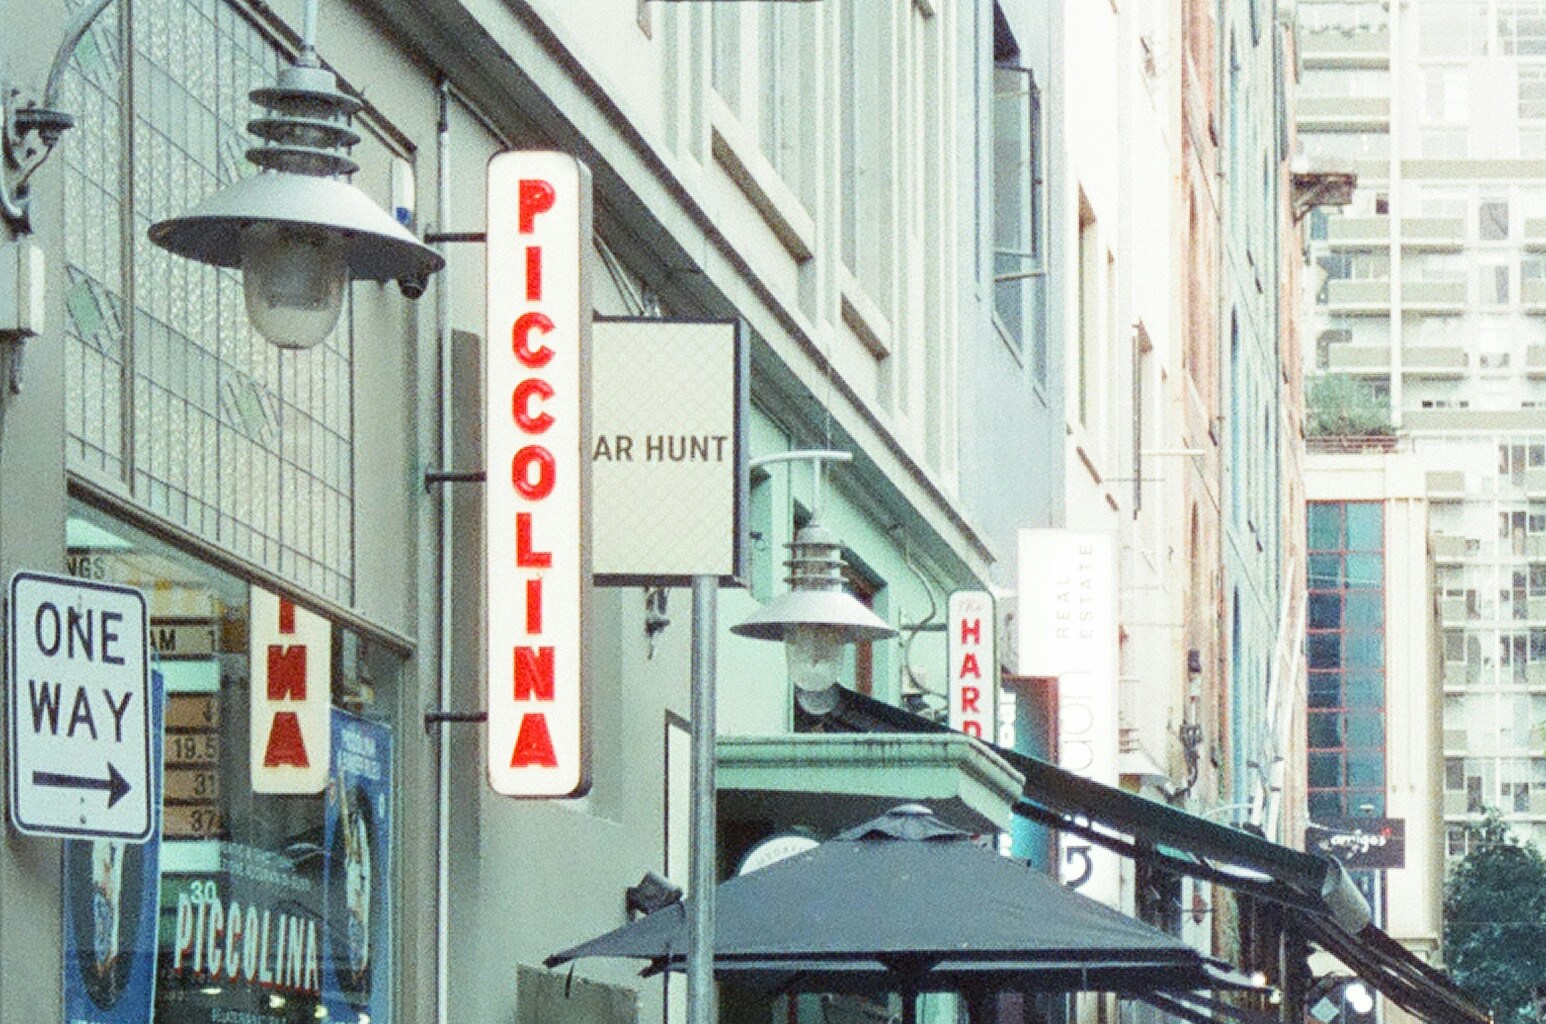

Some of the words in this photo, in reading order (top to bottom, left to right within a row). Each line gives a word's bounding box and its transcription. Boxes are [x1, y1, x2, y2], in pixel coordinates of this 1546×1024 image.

[510, 179, 559, 768] PICCOLINA
[646, 434, 728, 462] HUNT
[1079, 544, 1093, 639] ESTATE
[35, 601, 125, 666] ONE
[29, 679, 133, 743] WAY
[189, 879, 216, 904] 30
[174, 892, 320, 997] PICCOLINA
